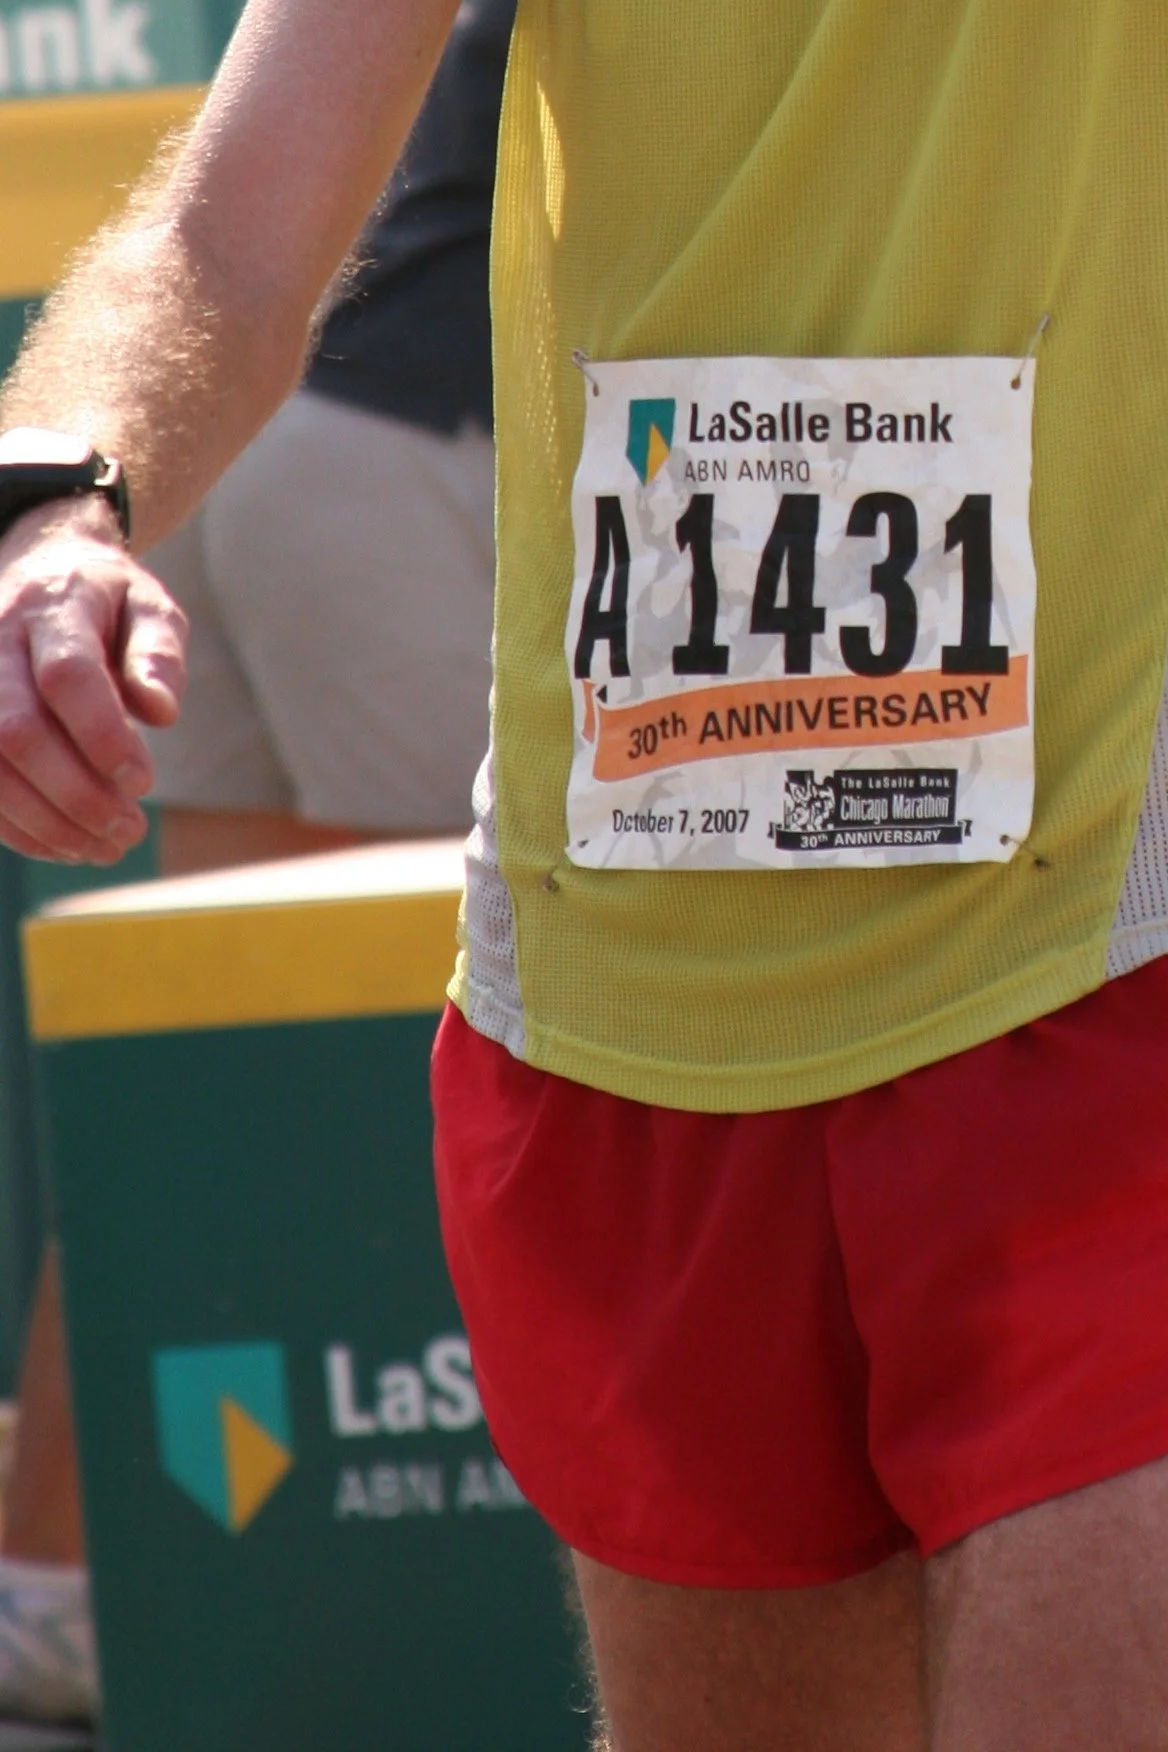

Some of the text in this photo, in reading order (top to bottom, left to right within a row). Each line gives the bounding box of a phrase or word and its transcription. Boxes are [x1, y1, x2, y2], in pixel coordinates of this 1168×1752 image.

[689, 401, 953, 443] LaSalle Bank
[685, 459, 811, 482] ABN AMRO
[627, 682, 992, 760] 30th ANNIVERSARY
[841, 775, 951, 789] The LaSalle Bank
[612, 808, 749, 837] October 7, 2007
[840, 793, 950, 825] Chicago Marathon
[800, 829, 941, 848] 30th ANNIVERSARY
[334, 1459, 443, 1521] ABN
